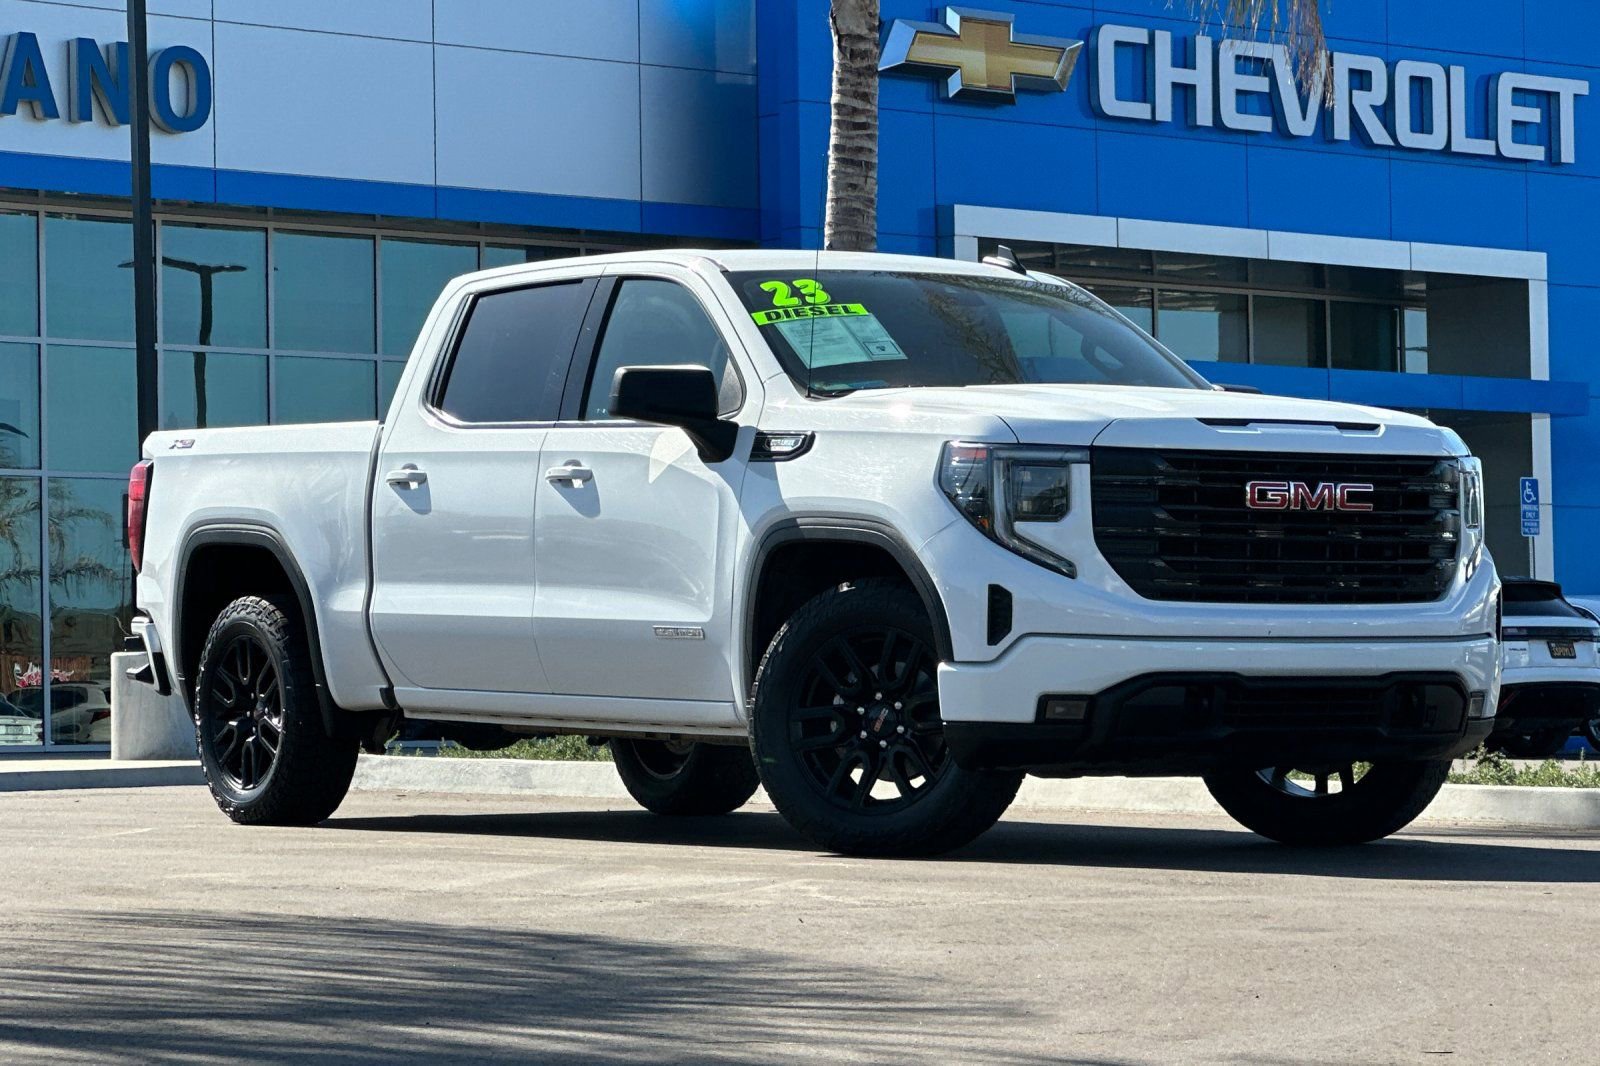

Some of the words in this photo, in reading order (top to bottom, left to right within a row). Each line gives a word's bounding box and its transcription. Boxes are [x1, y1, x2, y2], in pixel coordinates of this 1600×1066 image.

[0, 31, 211, 133] ANO
[1097, 24, 1589, 164] CHEVROLET
[759, 279, 831, 307] 23
[764, 304, 857, 322] DIESEL
[1246, 480, 1374, 511] GMC
